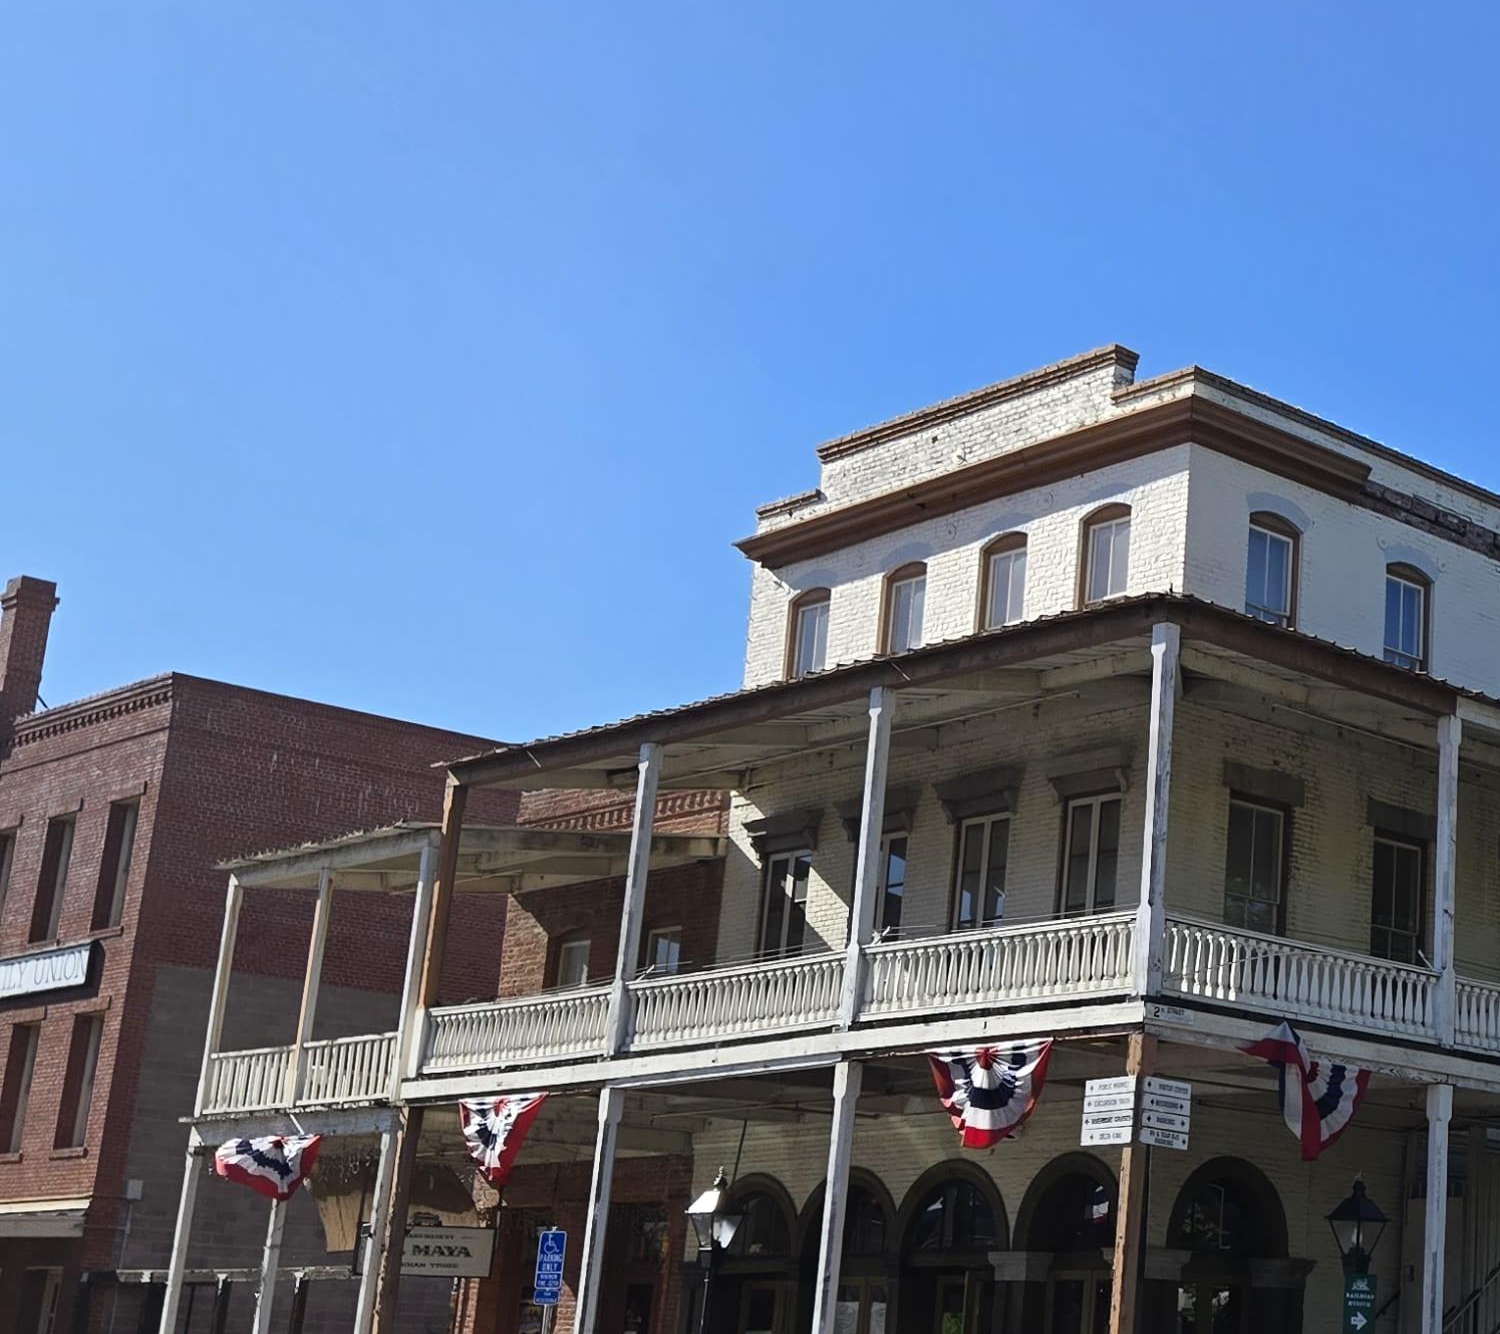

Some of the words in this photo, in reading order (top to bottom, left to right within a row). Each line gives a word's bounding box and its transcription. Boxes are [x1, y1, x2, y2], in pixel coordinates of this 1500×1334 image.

[34, 949, 89, 986] UNION
[412, 1244, 472, 1258] MAYA
[540, 1253, 562, 1262] PARKING
[542, 1263, 558, 1271] ONLY
